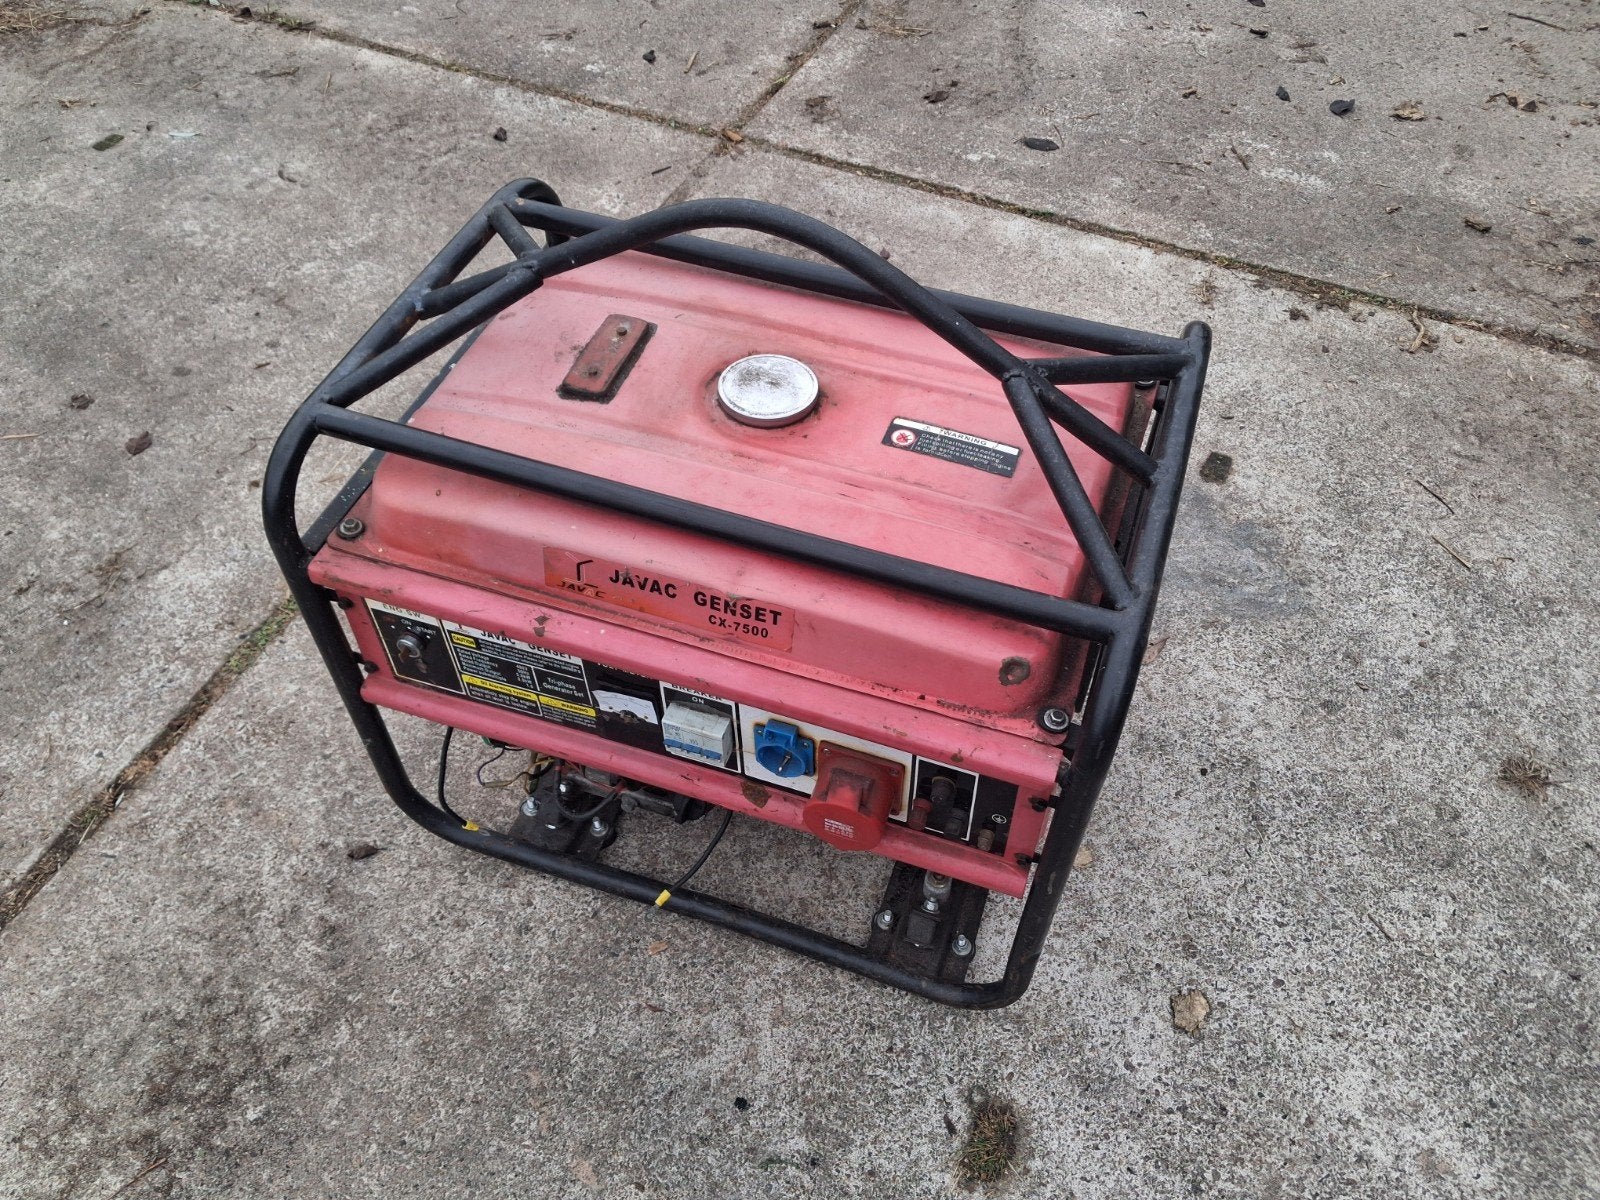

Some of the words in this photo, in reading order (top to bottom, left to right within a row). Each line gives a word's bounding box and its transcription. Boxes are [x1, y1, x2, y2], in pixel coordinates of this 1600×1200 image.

[609, 569, 677, 599] JAVAC
[693, 591, 782, 626] GENSET
[708, 614, 769, 639] CX-7500
[691, 696, 704, 704] ON
